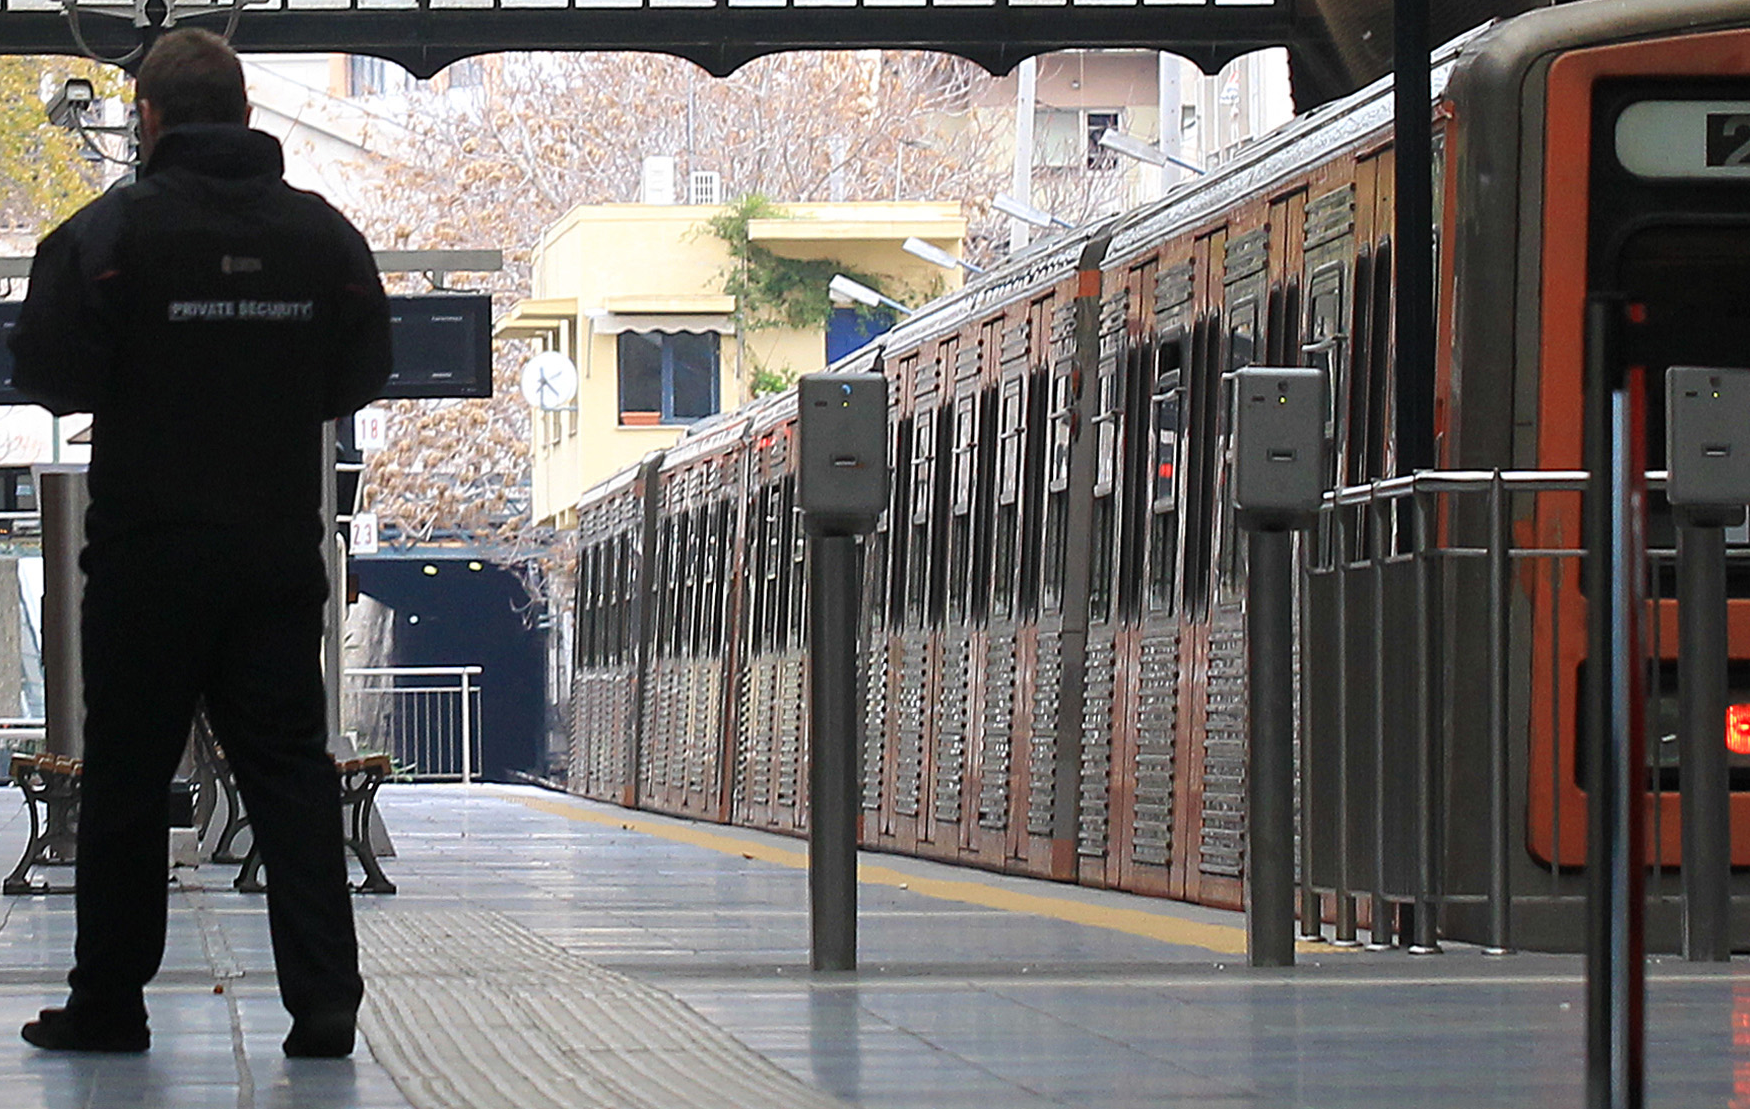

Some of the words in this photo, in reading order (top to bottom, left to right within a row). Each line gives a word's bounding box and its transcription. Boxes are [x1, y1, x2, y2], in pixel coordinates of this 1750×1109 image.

[171, 300, 235, 318] PRIVATE
[238, 299, 313, 318] SECURITY
[361, 419, 378, 440] 18
[352, 523, 373, 546] 23
